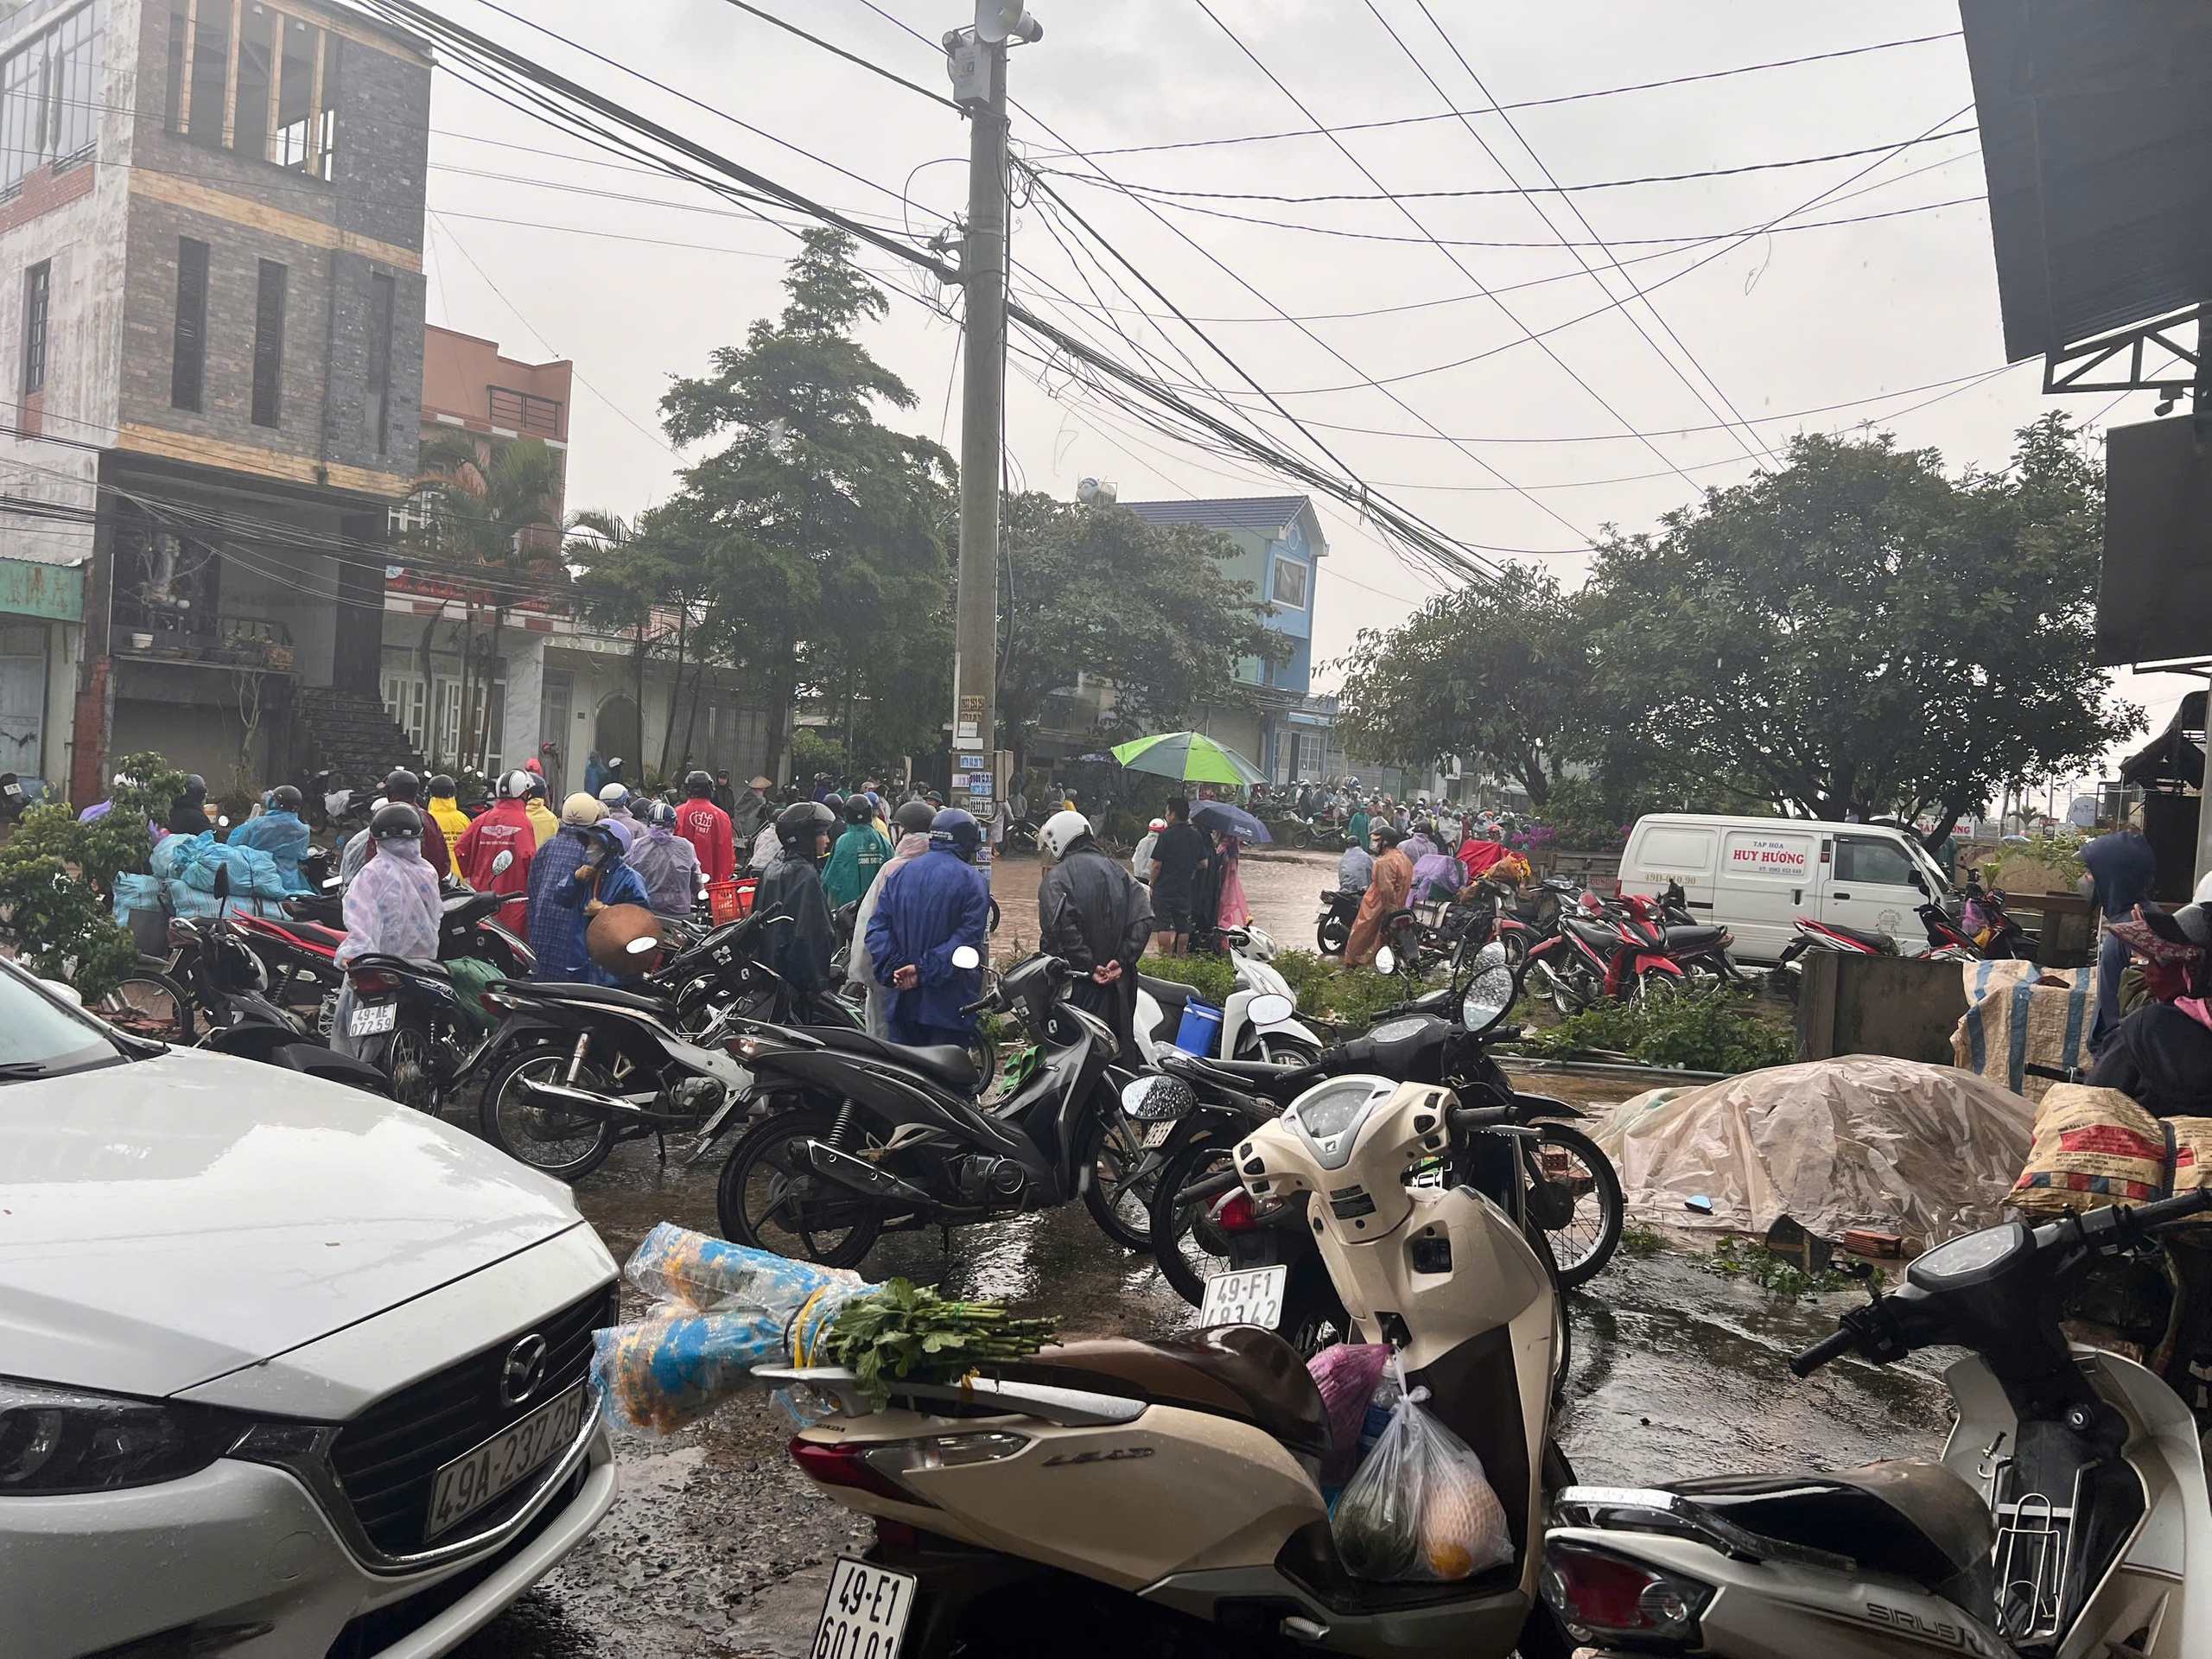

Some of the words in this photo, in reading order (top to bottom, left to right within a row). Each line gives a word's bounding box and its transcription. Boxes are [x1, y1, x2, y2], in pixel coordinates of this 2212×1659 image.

[1733, 849, 1759, 861] HUY
[1761, 850, 1804, 864] HƯƠNG
[357, 1005, 389, 1021] 49-AE
[351, 1018, 391, 1036] 072.59
[1217, 1272, 1271, 1304] 49-F1
[435, 1390, 580, 1522] 49A-237.25
[1041, 1447, 1155, 1466] LEAD
[838, 1567, 900, 1626] 49-E1
[1866, 1602, 1956, 1640] SIRIUS
